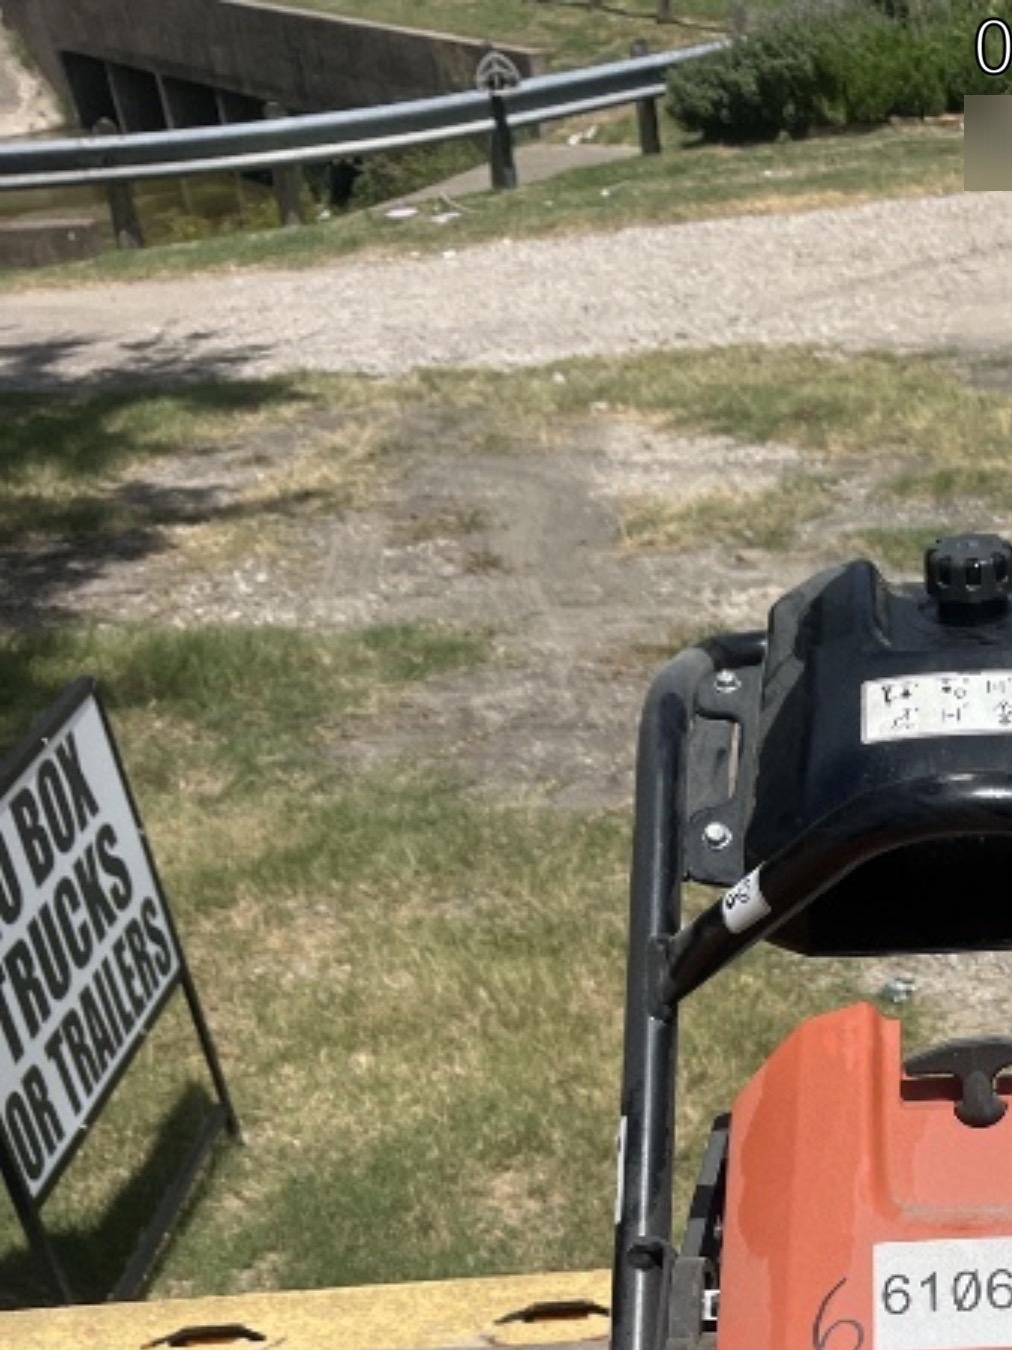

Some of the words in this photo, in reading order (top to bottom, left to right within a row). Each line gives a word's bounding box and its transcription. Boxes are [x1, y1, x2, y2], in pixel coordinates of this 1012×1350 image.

[0, 831, 23, 938] O
[9, 730, 99, 888] BOX
[0, 823, 133, 1063] TRUCKS
[5, 1064, 65, 1181] OR
[44, 896, 172, 1115] TRAILERS
